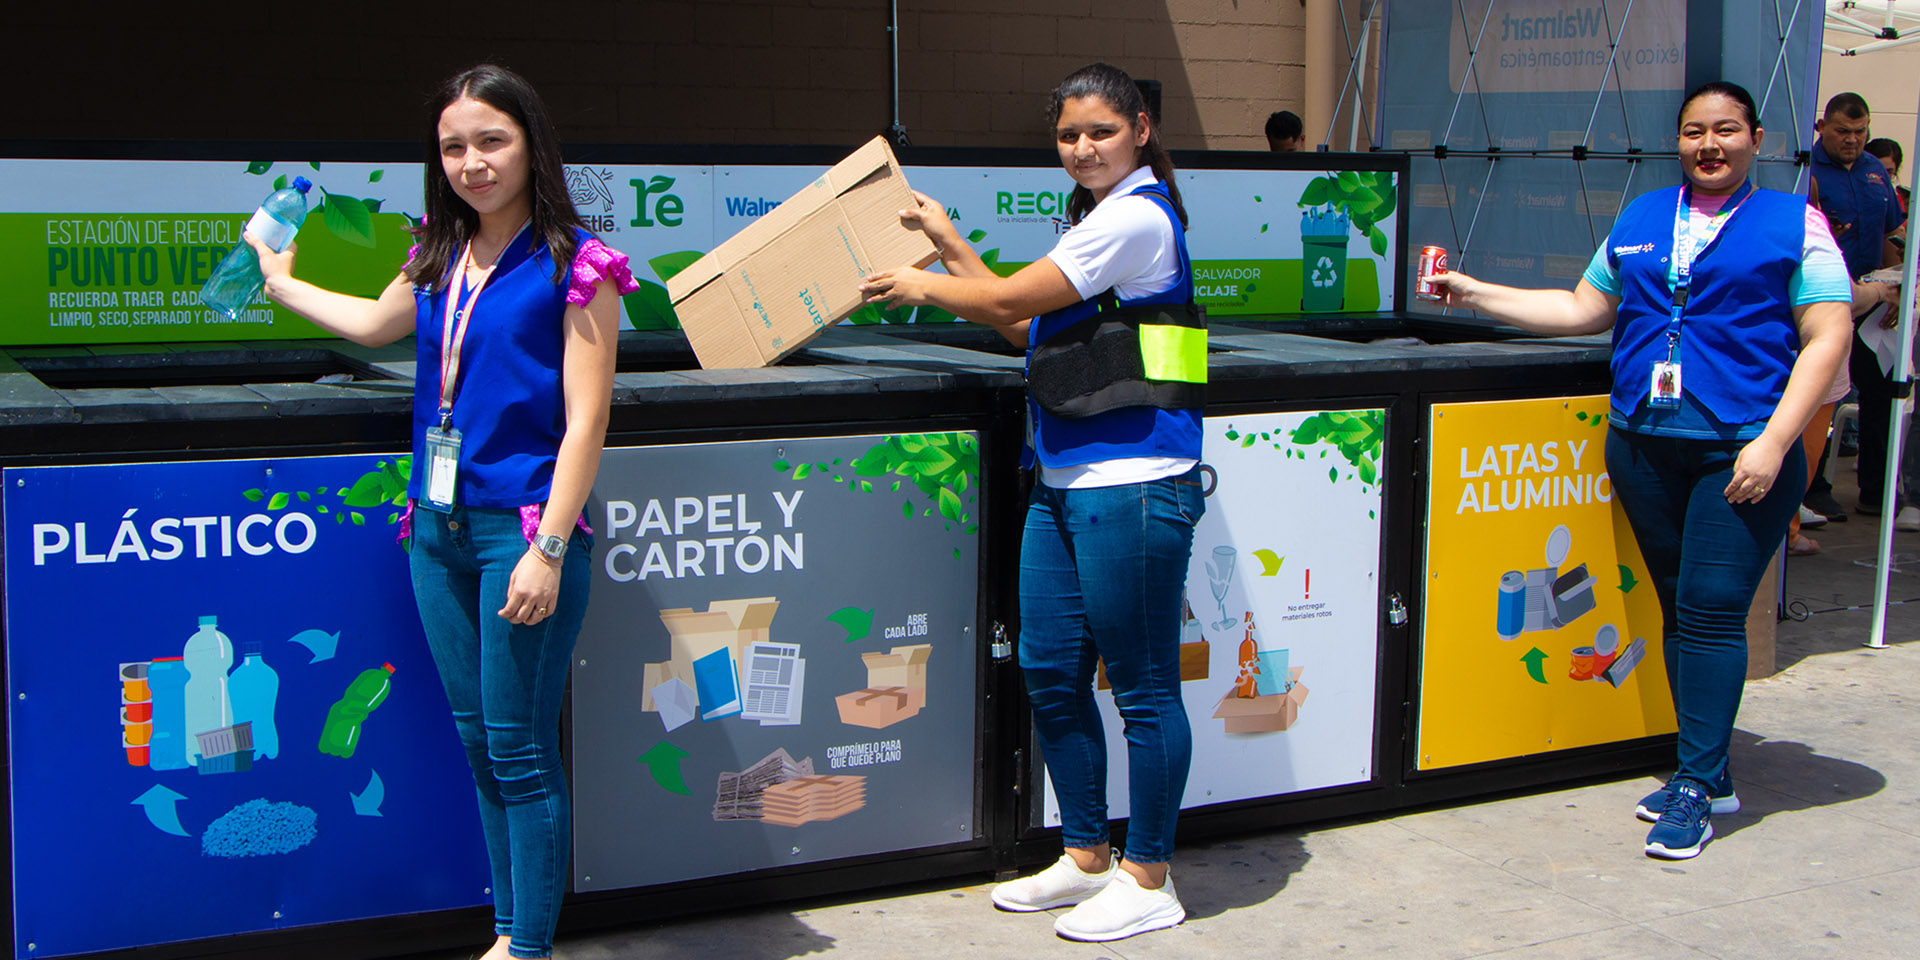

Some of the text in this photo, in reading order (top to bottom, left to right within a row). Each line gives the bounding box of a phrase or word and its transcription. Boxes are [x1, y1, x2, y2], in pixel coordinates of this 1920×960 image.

[725, 196, 783, 217] Walm
[46, 216, 140, 245] ESTACIÓN
[144, 220, 169, 245] DE
[1679, 233, 1691, 277] REMESAS
[48, 246, 158, 287] PUNTO
[1194, 267, 1261, 281] SALVADOR
[48, 291, 119, 308] RECUERDA
[122, 291, 165, 307] TRAER
[1193, 284, 1239, 298] ICLAJE
[49, 311, 96, 329] LIMPIO,
[193, 310, 202, 325] Y
[1460, 439, 1588, 479] LATAS Y
[1456, 472, 1616, 515] ALUMINIO
[606, 490, 804, 539] PAPEL Y
[33, 508, 317, 566] PLÁSTICO
[604, 529, 804, 583] CARTÓN
[1282, 610, 1333, 621] materiales rotos
[1298, 602, 1326, 611] entregar
[907, 613, 928, 627] ABRE
[884, 624, 928, 640] CADA LADO
[826, 739, 902, 760] COMPRÍMELO PARA
[830, 750, 902, 770] QUE QUEDE PLANO
